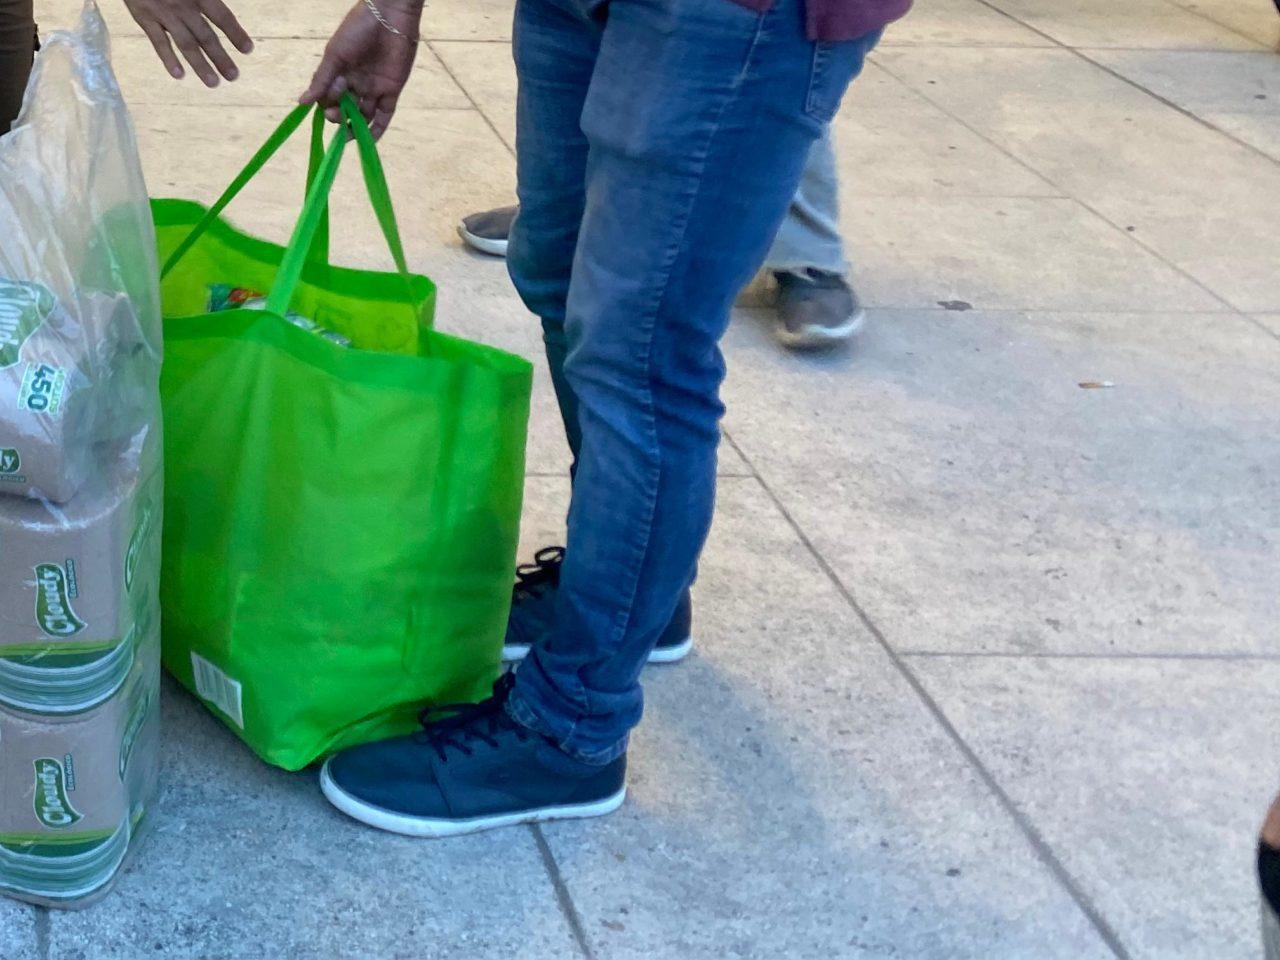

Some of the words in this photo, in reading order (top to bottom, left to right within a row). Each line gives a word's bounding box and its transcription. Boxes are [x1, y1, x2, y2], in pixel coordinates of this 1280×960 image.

[27, 364, 56, 411] 450
[40, 568, 76, 633] Cloudy
[38, 762, 72, 825] Cloudy
